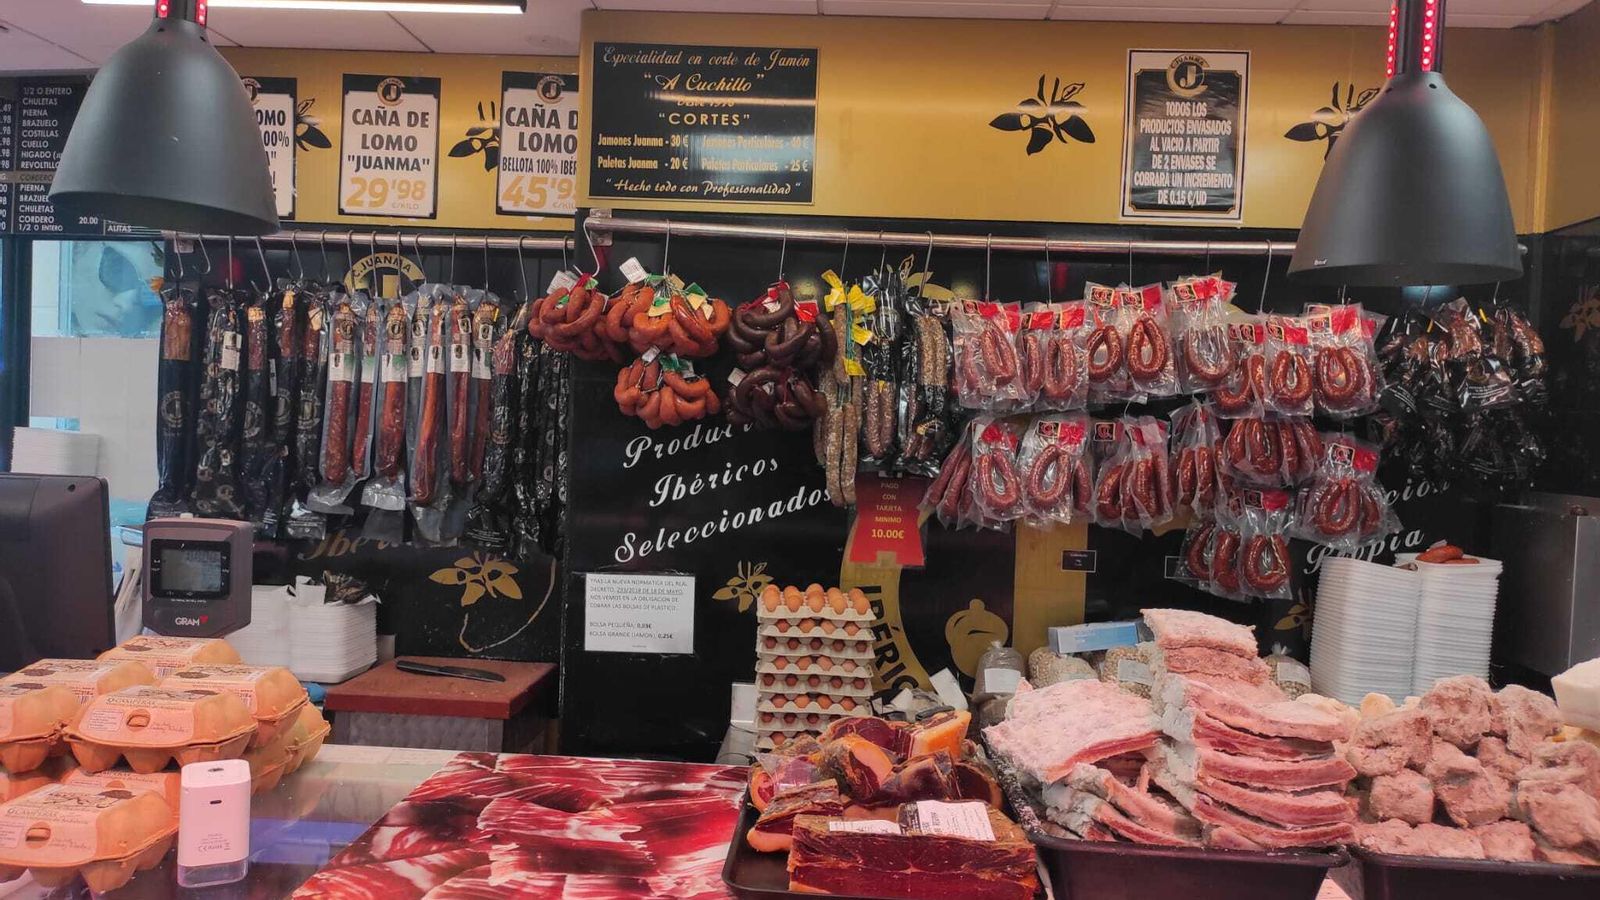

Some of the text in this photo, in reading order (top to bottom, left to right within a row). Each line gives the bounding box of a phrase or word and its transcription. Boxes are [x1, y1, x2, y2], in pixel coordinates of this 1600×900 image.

[603, 46, 810, 70] Especialidad en corte de Jamón
[22, 109, 48, 117] PIERNA
[352, 105, 430, 128] CAÑA DE
[505, 103, 578, 130] CAÑA D
[1166, 102, 1207, 116] TODOS LOS
[256, 109, 286, 126] OMO
[0, 126, 12, 134] .98
[22, 130, 59, 138] COSTILLAS
[1140, 118, 1232, 136] PRODUCTOS ENVASADOS
[0, 138, 10, 146] .98
[263, 130, 289, 148] 00%
[361, 133, 418, 152] LOMO
[518, 132, 578, 154] LOMO
[598, 133, 631, 147] Jamones
[633, 134, 663, 147] Juanma
[670, 134, 680, 147] 30
[1150, 137, 1220, 153] AL VACIO A PARTIR
[348, 154, 430, 172] "JUANMA"
[502, 156, 534, 173] BELLOTA
[536, 158, 558, 174] 100%
[598, 156, 626, 170] Paletas
[628, 157, 658, 170] Juanma
[670, 158, 680, 170] 20
[732, 158, 778, 172] Particulares
[790, 160, 800, 172] 25
[1152, 154, 1216, 170] DE 2 ENVASES SE
[654, 181, 677, 192] todo
[680, 184, 698, 192] con
[1134, 171, 1232, 188] COBRARA UN INCREMENTO
[20, 194, 49, 202] BRAZUEL
[502, 175, 576, 209] 45'9
[1158, 190, 1168, 204] DE
[1170, 190, 1186, 205] 0.15
[19, 204, 54, 213] CHULETAS
[18, 215, 54, 224] CORDERO
[79, 216, 98, 225] 20.00
[649, 458, 778, 507] Ibéricos
[615, 486, 832, 562] Seleccionados
[872, 528, 904, 540] 10.00€
[175, 616, 200, 626] GRAM
